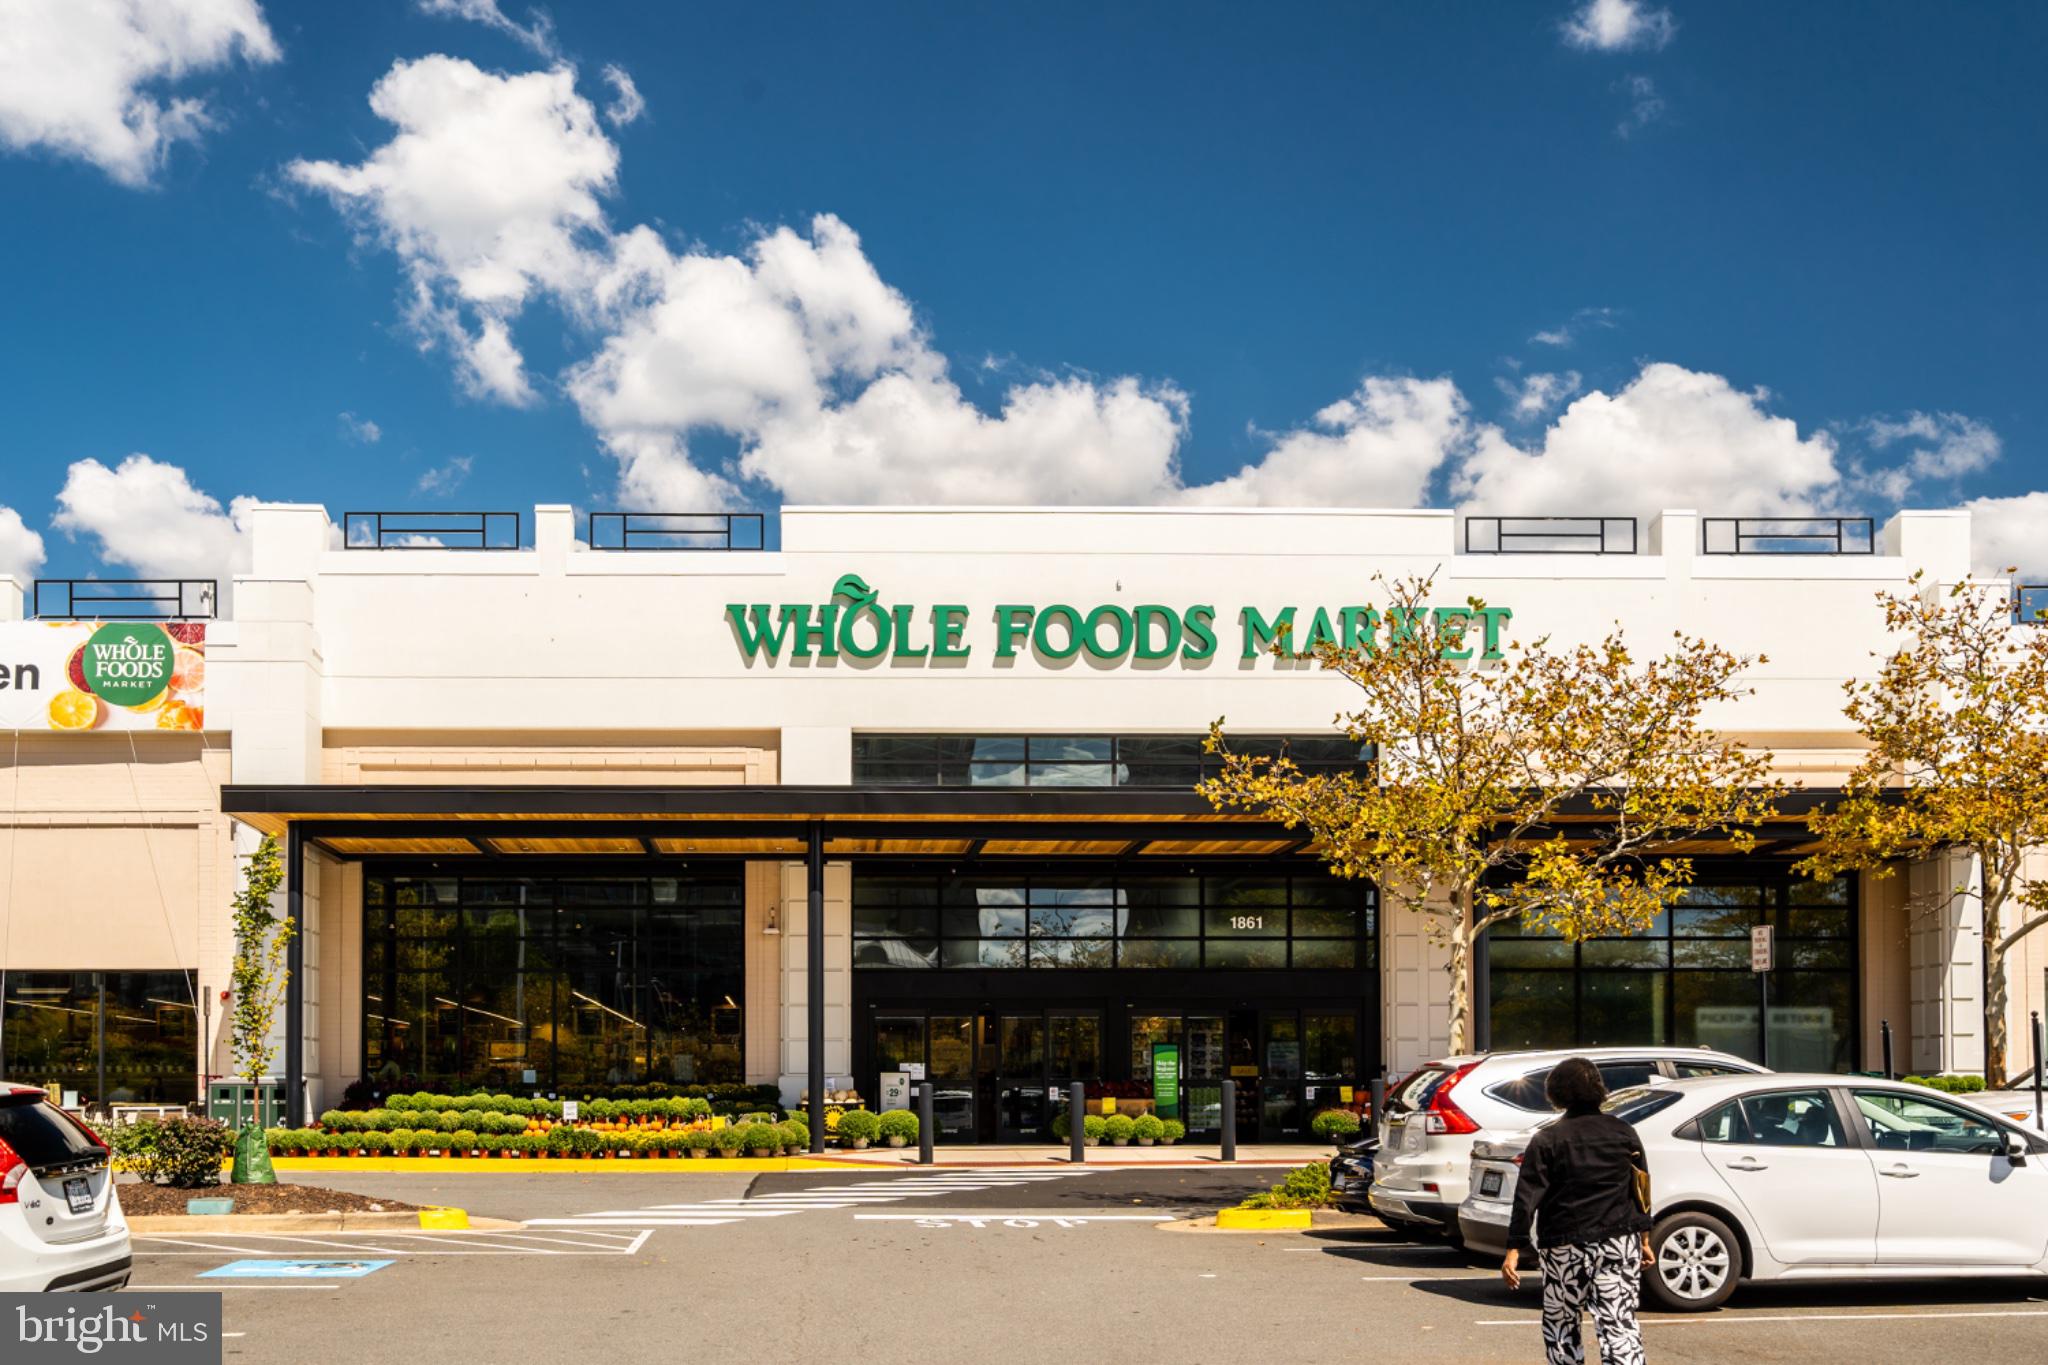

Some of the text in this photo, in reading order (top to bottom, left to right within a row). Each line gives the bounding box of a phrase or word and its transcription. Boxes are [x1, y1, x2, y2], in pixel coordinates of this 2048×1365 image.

[725, 600, 1514, 661] WHOLE FOODS MARKET
[92, 642, 166, 660] WHOLE
[96, 661, 163, 678] FOODS
[103, 680, 153, 688] MARKET
[1230, 916, 1263, 929] 1861
[912, 1217, 1089, 1228] STOP
